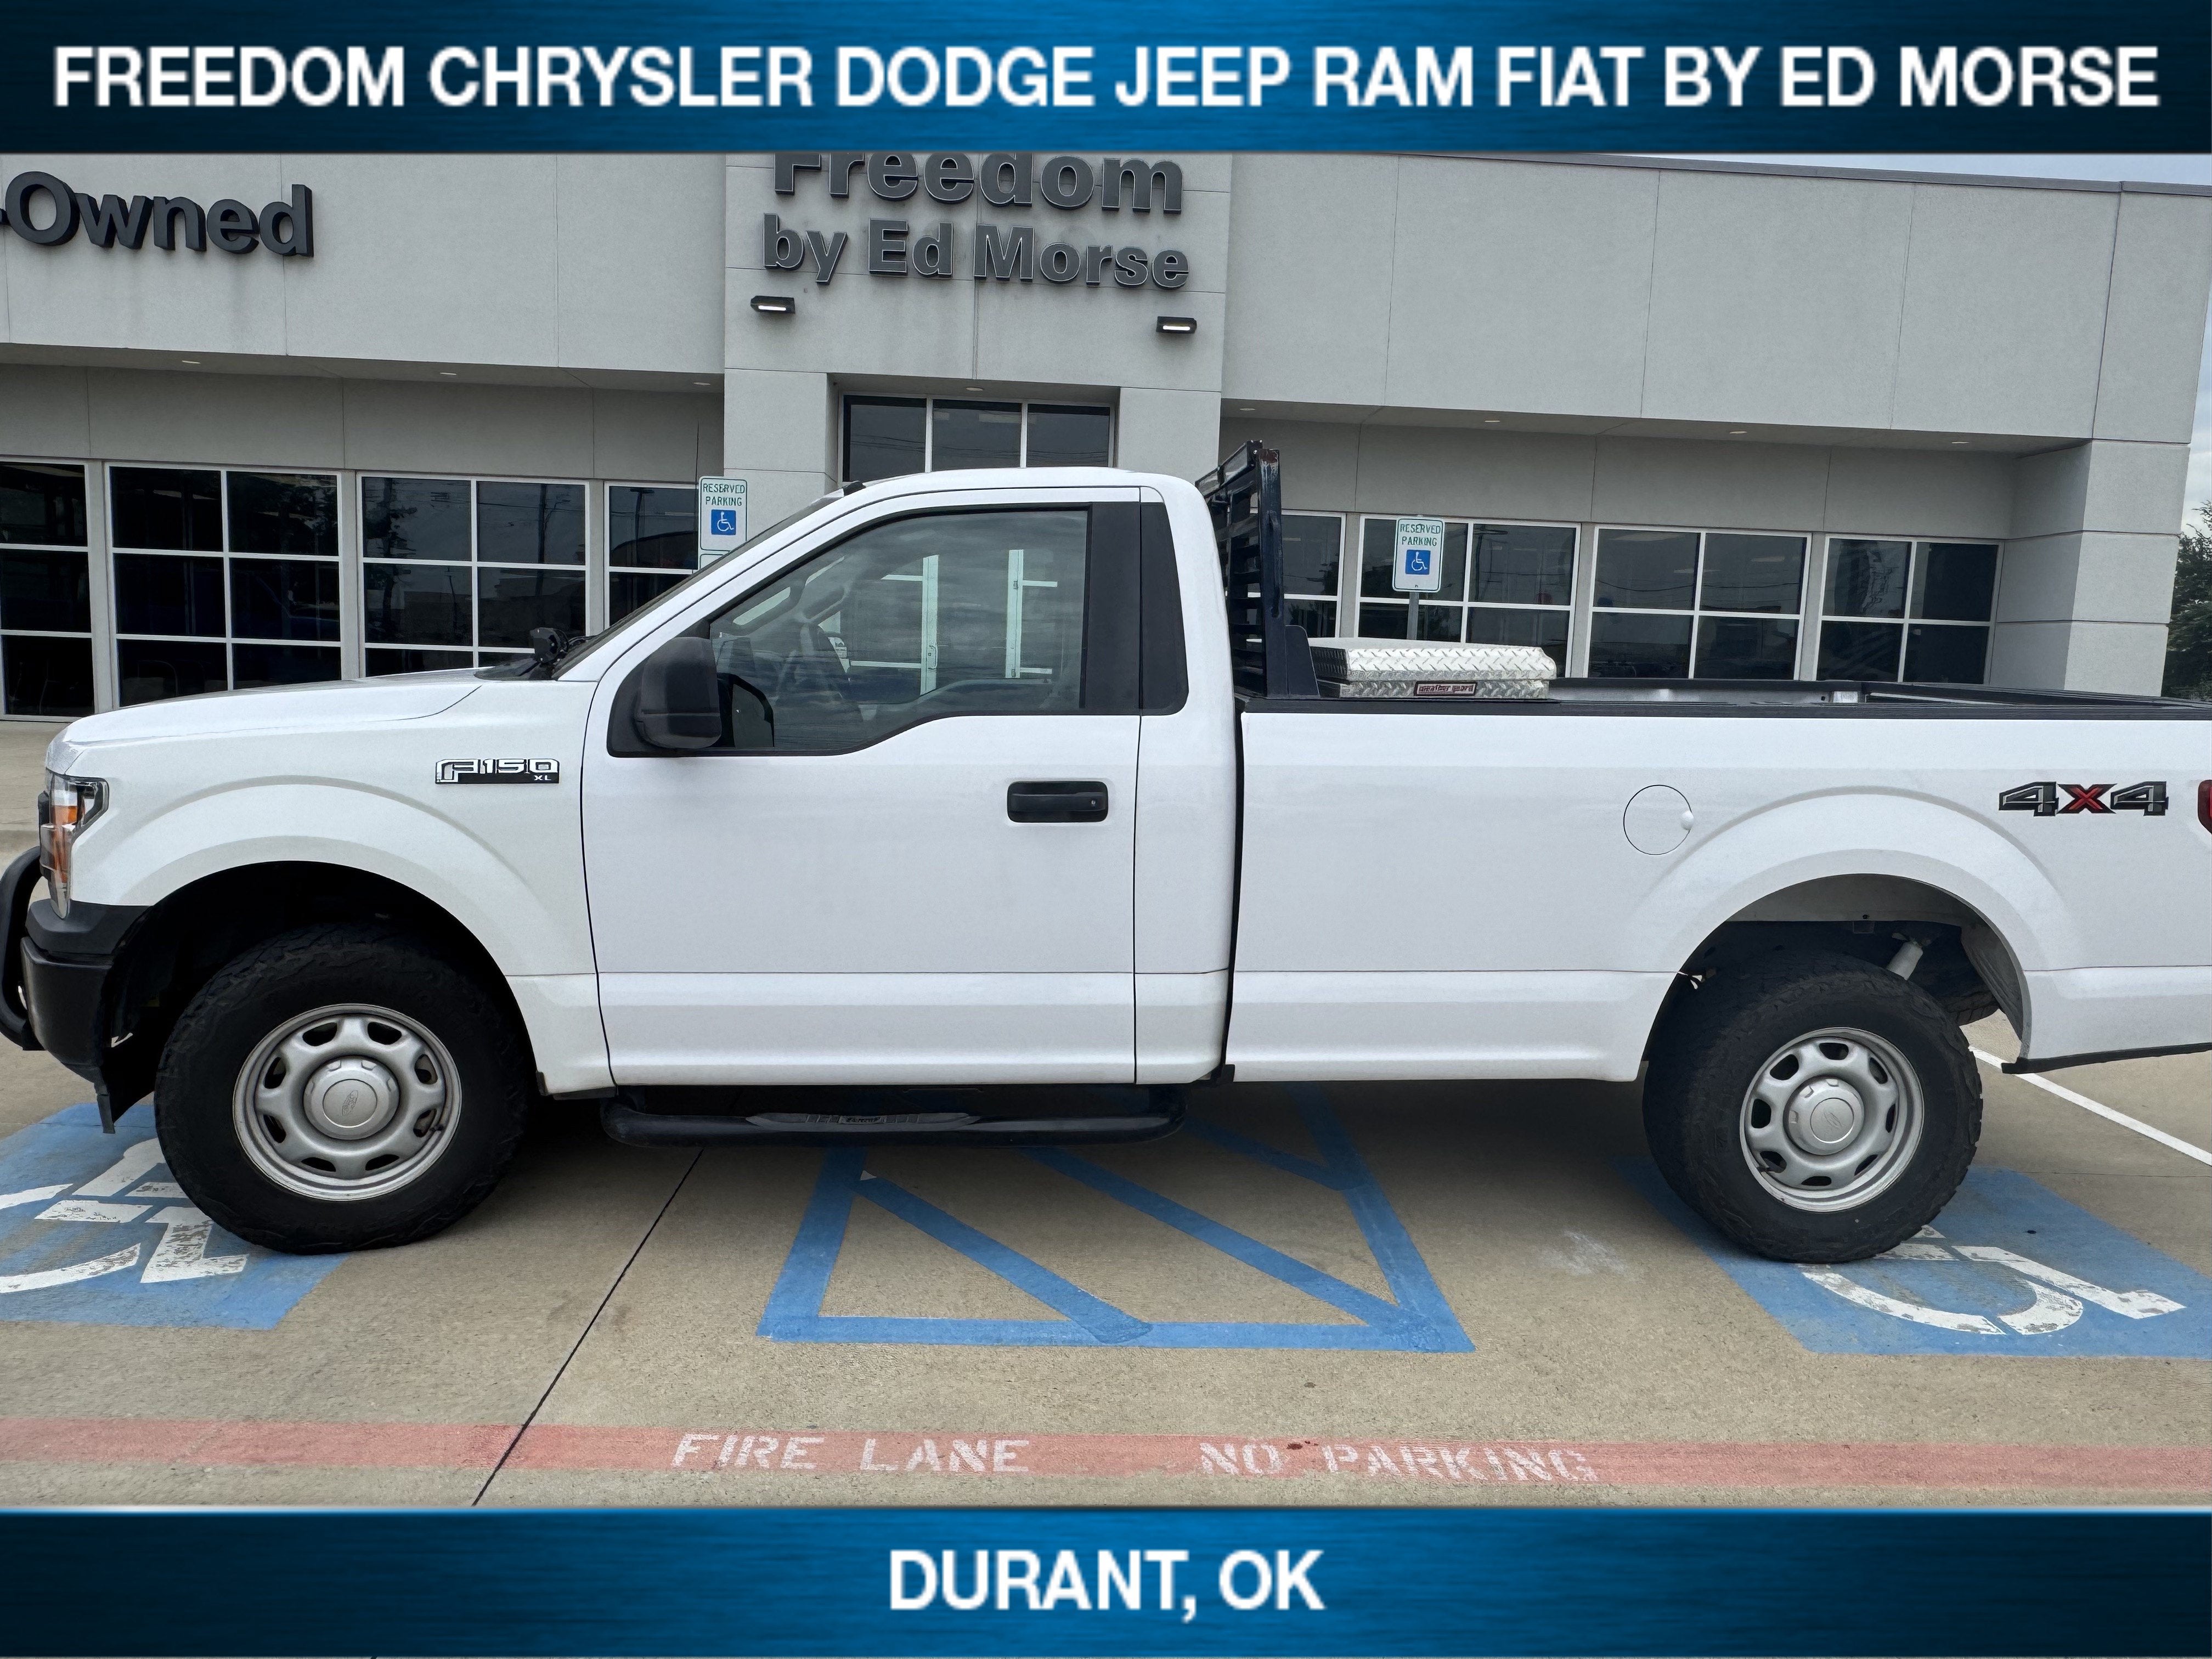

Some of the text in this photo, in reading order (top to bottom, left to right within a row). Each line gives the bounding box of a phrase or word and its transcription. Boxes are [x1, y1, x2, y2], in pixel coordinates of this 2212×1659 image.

[774, 153, 1183, 213] Freedom
[763, 213, 1189, 290] by Ed Morse
[703, 483, 746, 494] RESERVED
[706, 496, 742, 506] PARKING
[1400, 523, 1441, 534] RESERVED
[1402, 536, 1437, 546] PARKING
[670, 1433, 1029, 1473] FIRE LANE
[1199, 1442, 1598, 1483] NO PARKING
